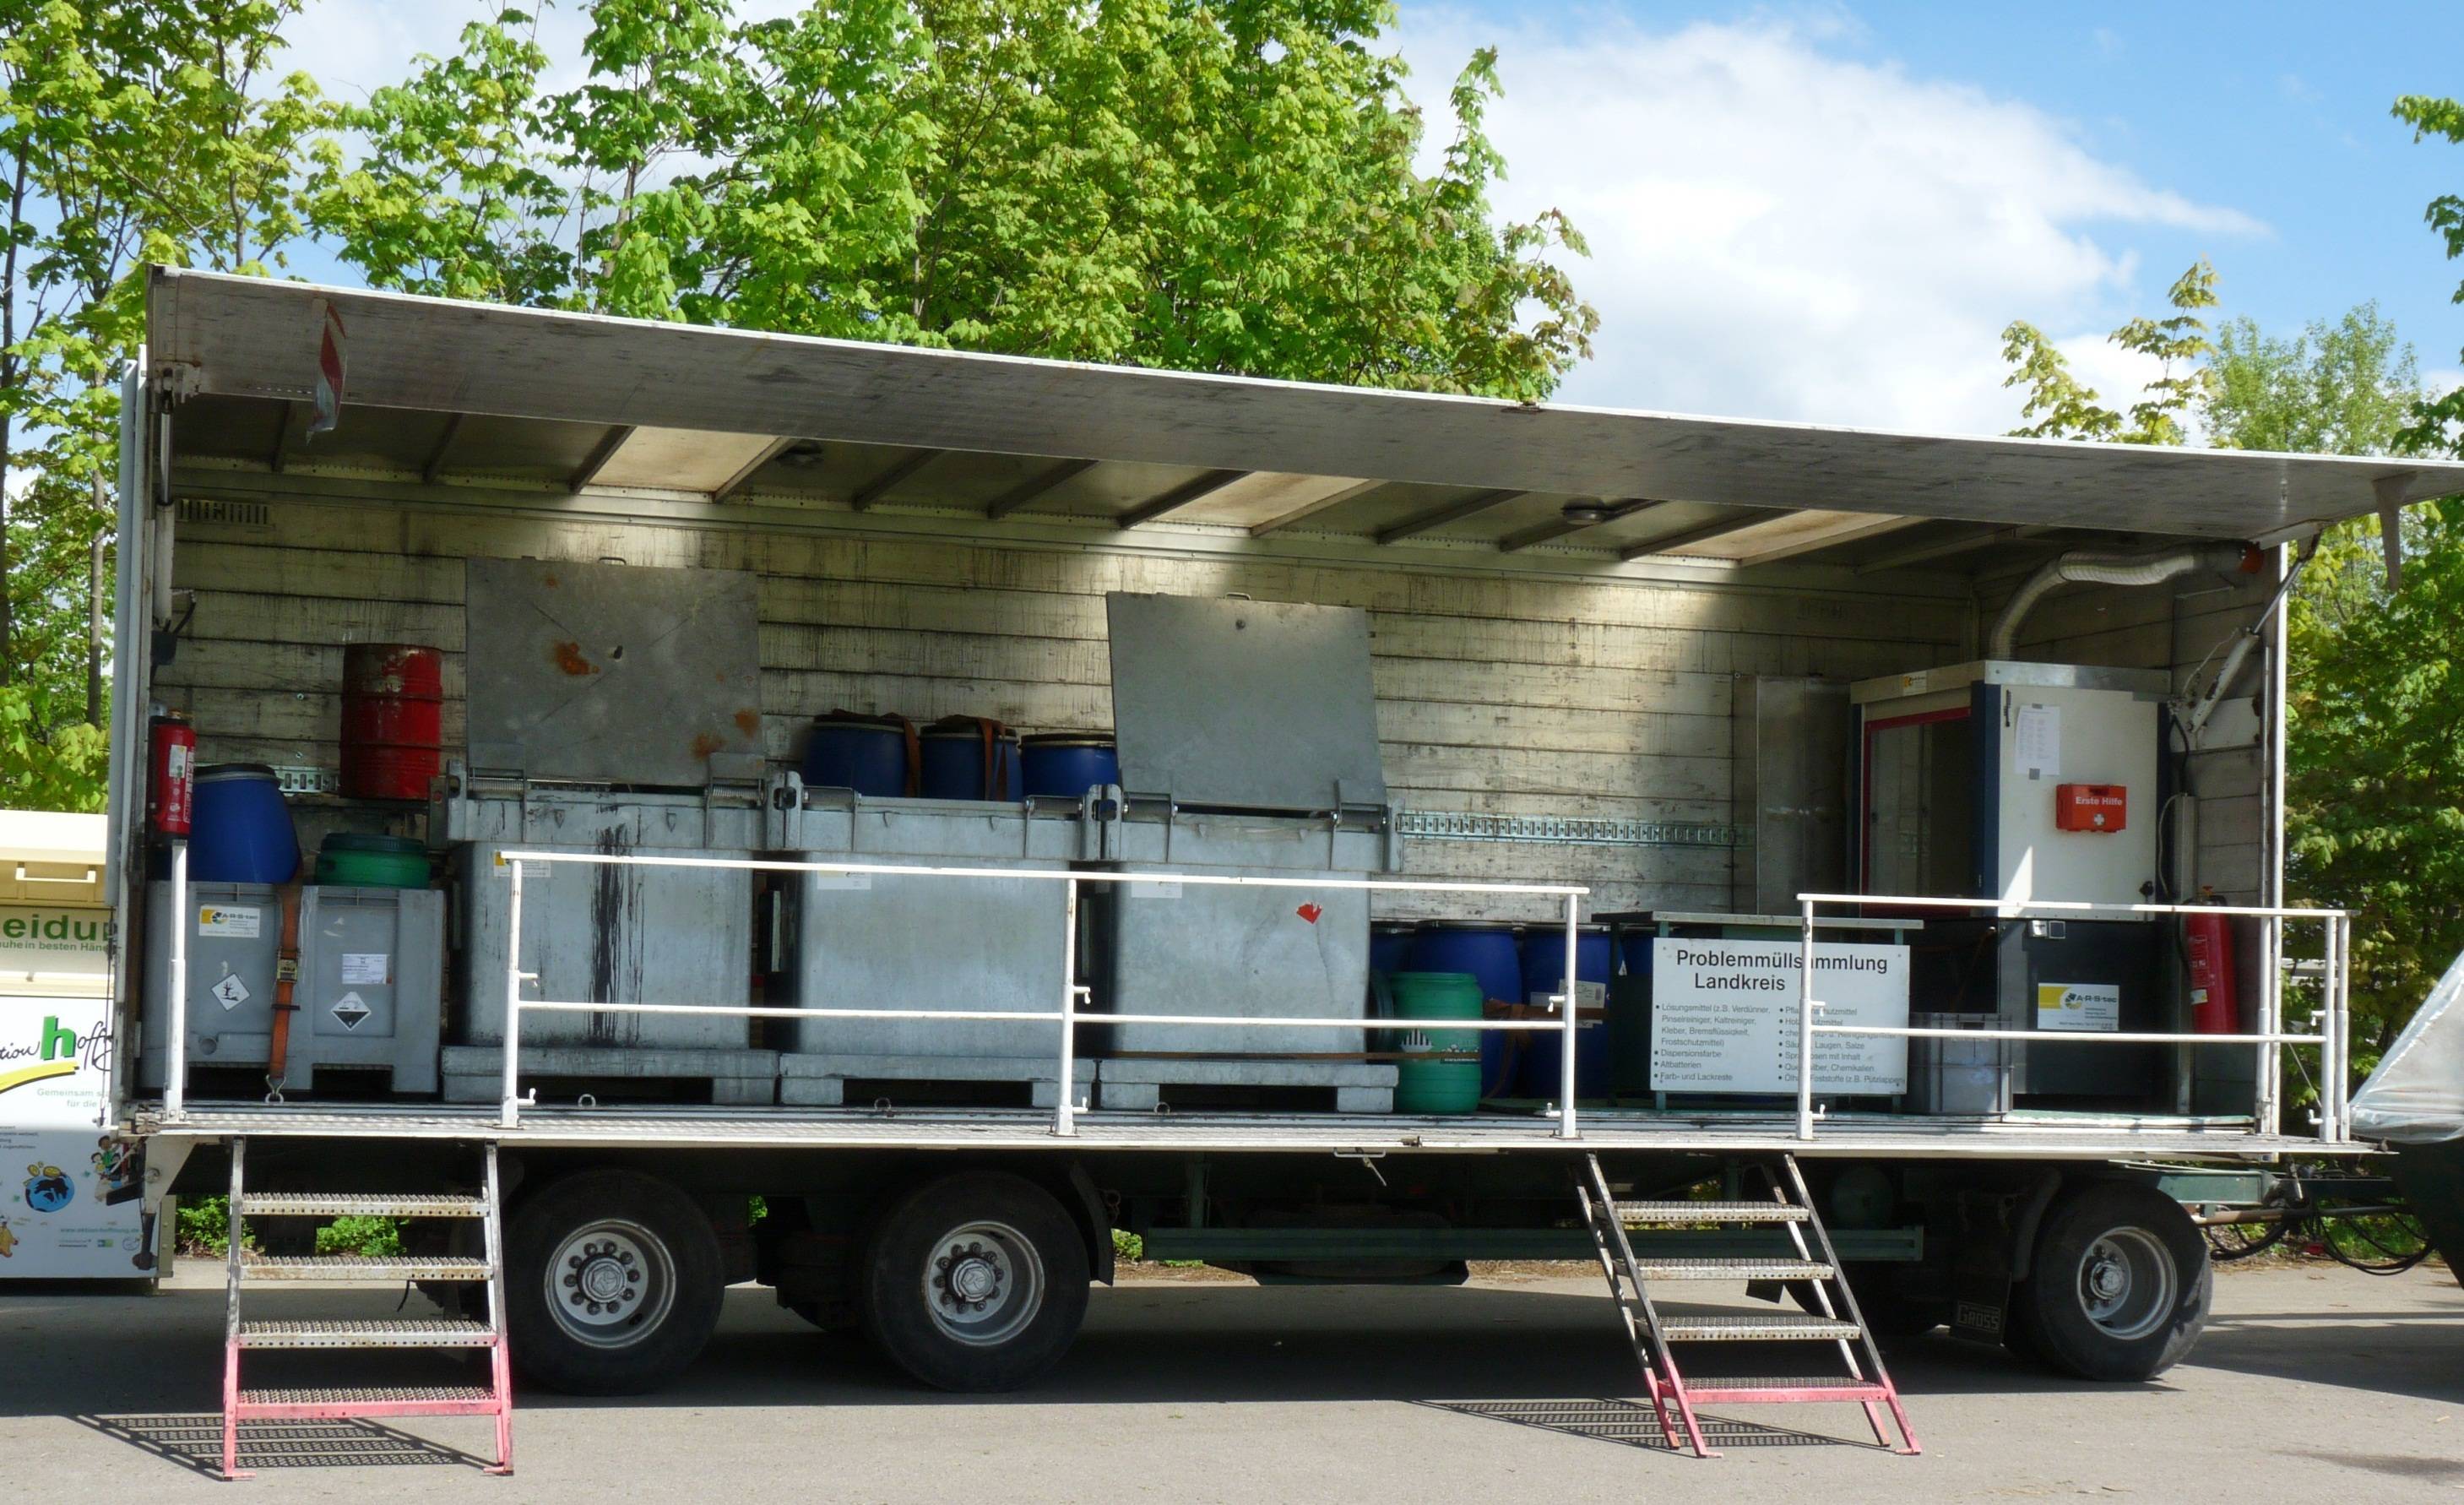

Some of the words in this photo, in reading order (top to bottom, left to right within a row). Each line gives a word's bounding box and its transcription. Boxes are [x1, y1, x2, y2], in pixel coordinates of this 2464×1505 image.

[2076, 796, 2099, 805] Erste
[2102, 797, 2123, 806] Hilfe
[39, 942, 77, 951] besten
[1677, 949, 1888, 975] Problemmüllsmmlung
[1695, 973, 1786, 991] Landkreis
[1662, 1004, 1712, 1013] Lösungsmittel
[1731, 1005, 1771, 1014] Verdünner,
[1662, 1014, 1712, 1024] Pinselreiniger,
[1661, 1026, 1688, 1036] Kleber,
[1815, 1040, 1843, 1051] Laugen,
[1845, 1041, 1865, 1050] Salze
[1660, 1049, 1723, 1059] Dispersionsfarbe
[1660, 1060, 1702, 1069] Altbatterien
[1831, 1064, 1875, 1073] Chemikalien
[1660, 1071, 1681, 1081] Farb-
[1681, 1073, 1696, 1081] und
[1697, 1073, 1734, 1081] Lackreste
[37, 1087, 94, 1096] Gemeinsam
[67, 1099, 79, 1107] für
[83, 1099, 97, 1107] die
